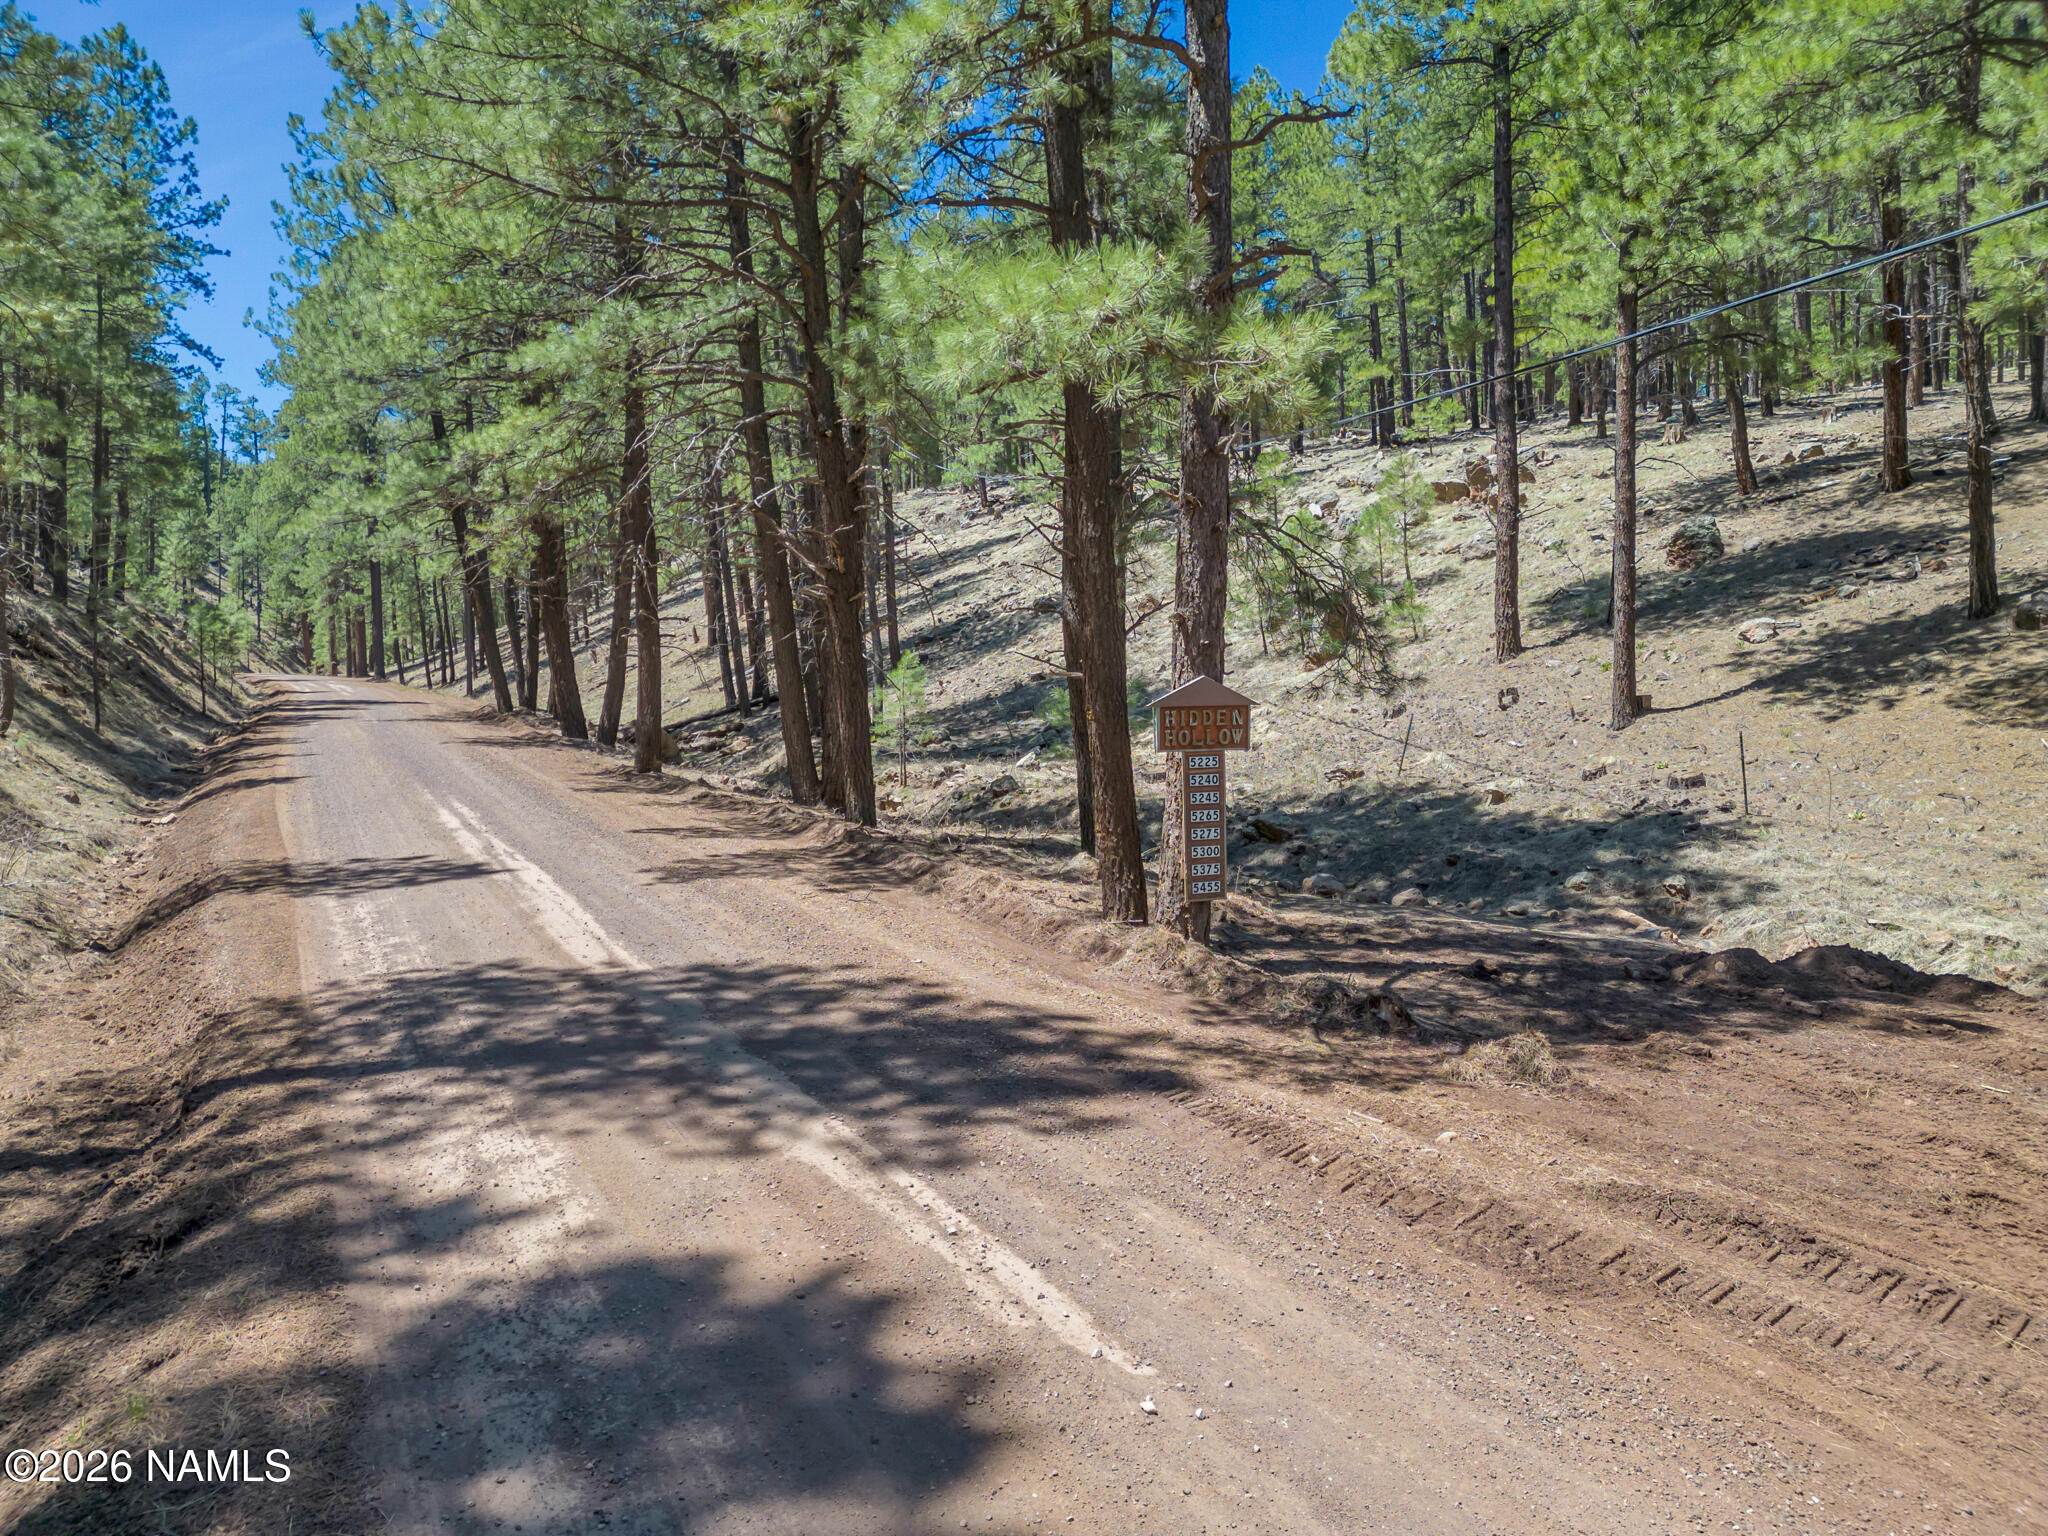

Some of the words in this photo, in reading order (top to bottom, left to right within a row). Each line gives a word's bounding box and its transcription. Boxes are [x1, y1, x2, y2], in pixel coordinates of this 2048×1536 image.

[1164, 709, 1243, 727] HIDDEN
[1164, 728, 1243, 746] HOLLOW
[1190, 756, 1218, 768] 5225
[1190, 774, 1218, 786] 5240
[1191, 792, 1219, 803] 5245
[1192, 810, 1219, 821] 5265
[1192, 828, 1219, 839] 5275
[1193, 846, 1220, 857] 5300
[1193, 864, 1220, 875] 5375
[1193, 882, 1220, 893] 5455
